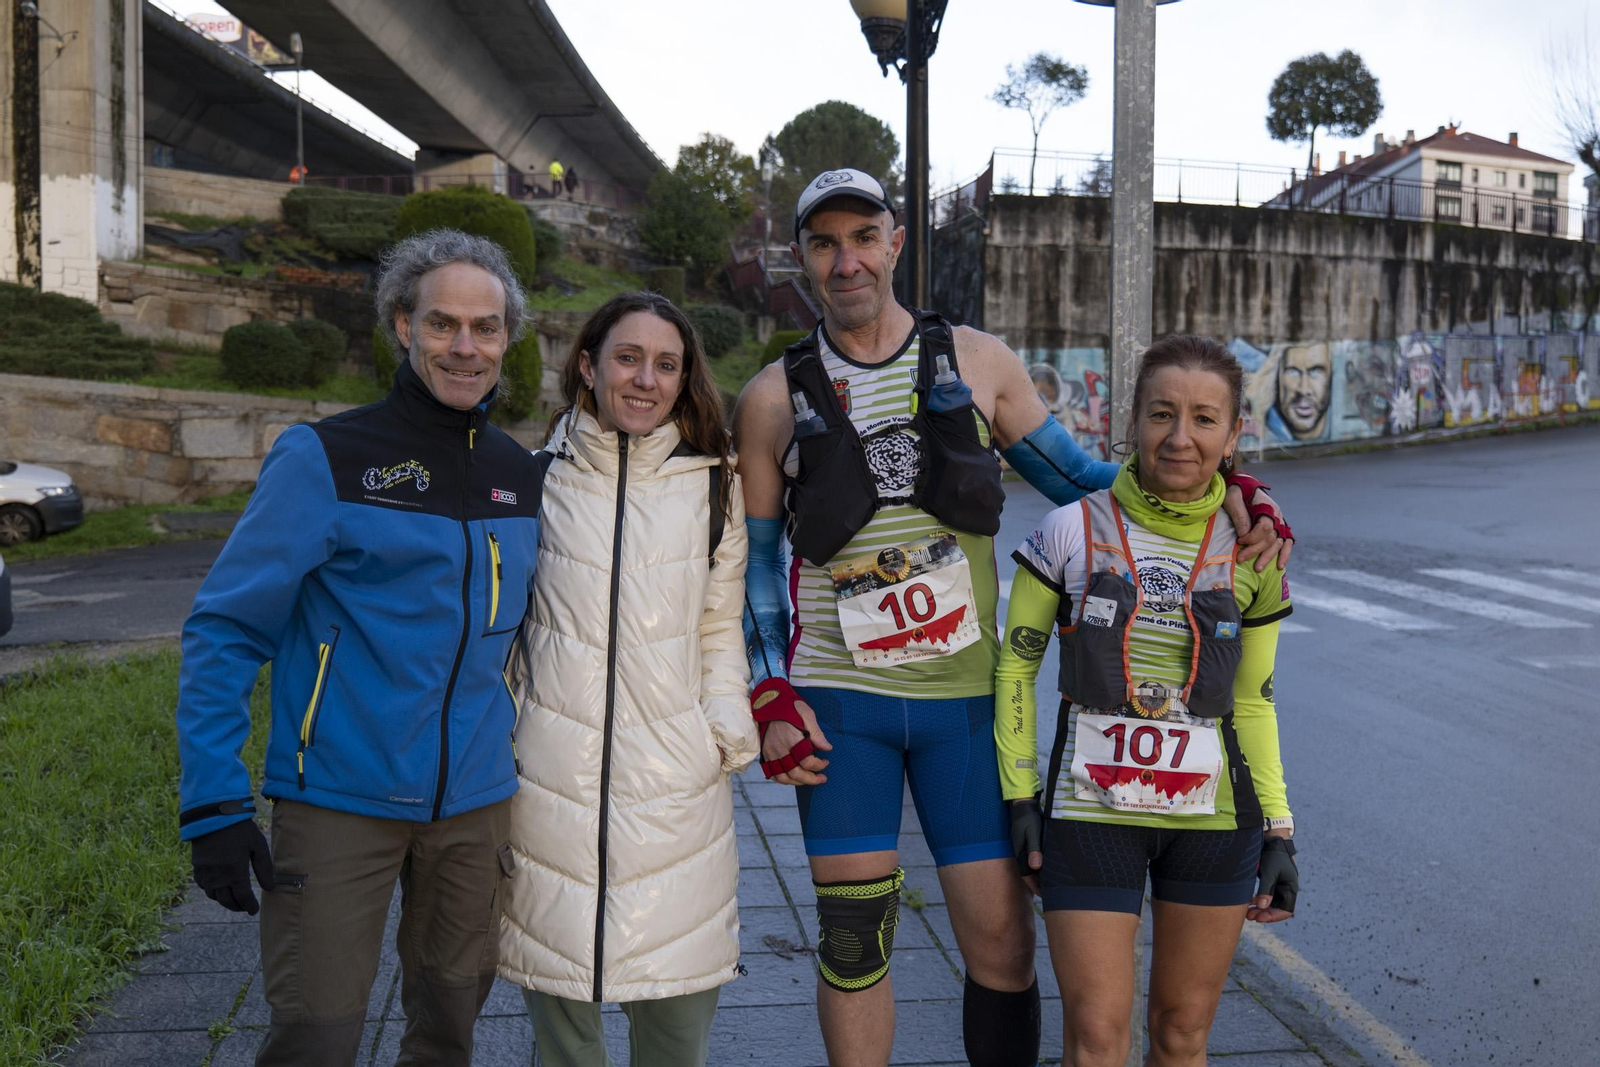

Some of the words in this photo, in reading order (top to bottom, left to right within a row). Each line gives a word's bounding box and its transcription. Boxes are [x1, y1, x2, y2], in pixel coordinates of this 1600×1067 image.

[867, 418, 892, 432] Montes
[394, 474, 414, 485] ciclista
[877, 581, 937, 631] 10
[1086, 614, 1110, 628] 226ERS
[1134, 615, 1155, 624] omé
[1155, 618, 1168, 627] de
[1168, 620, 1189, 630] Piñe
[1011, 679, 1024, 705] Nocedo
[1013, 705, 1024, 715] do
[1013, 715, 1024, 735] Trail
[1102, 722, 1191, 770] 107
